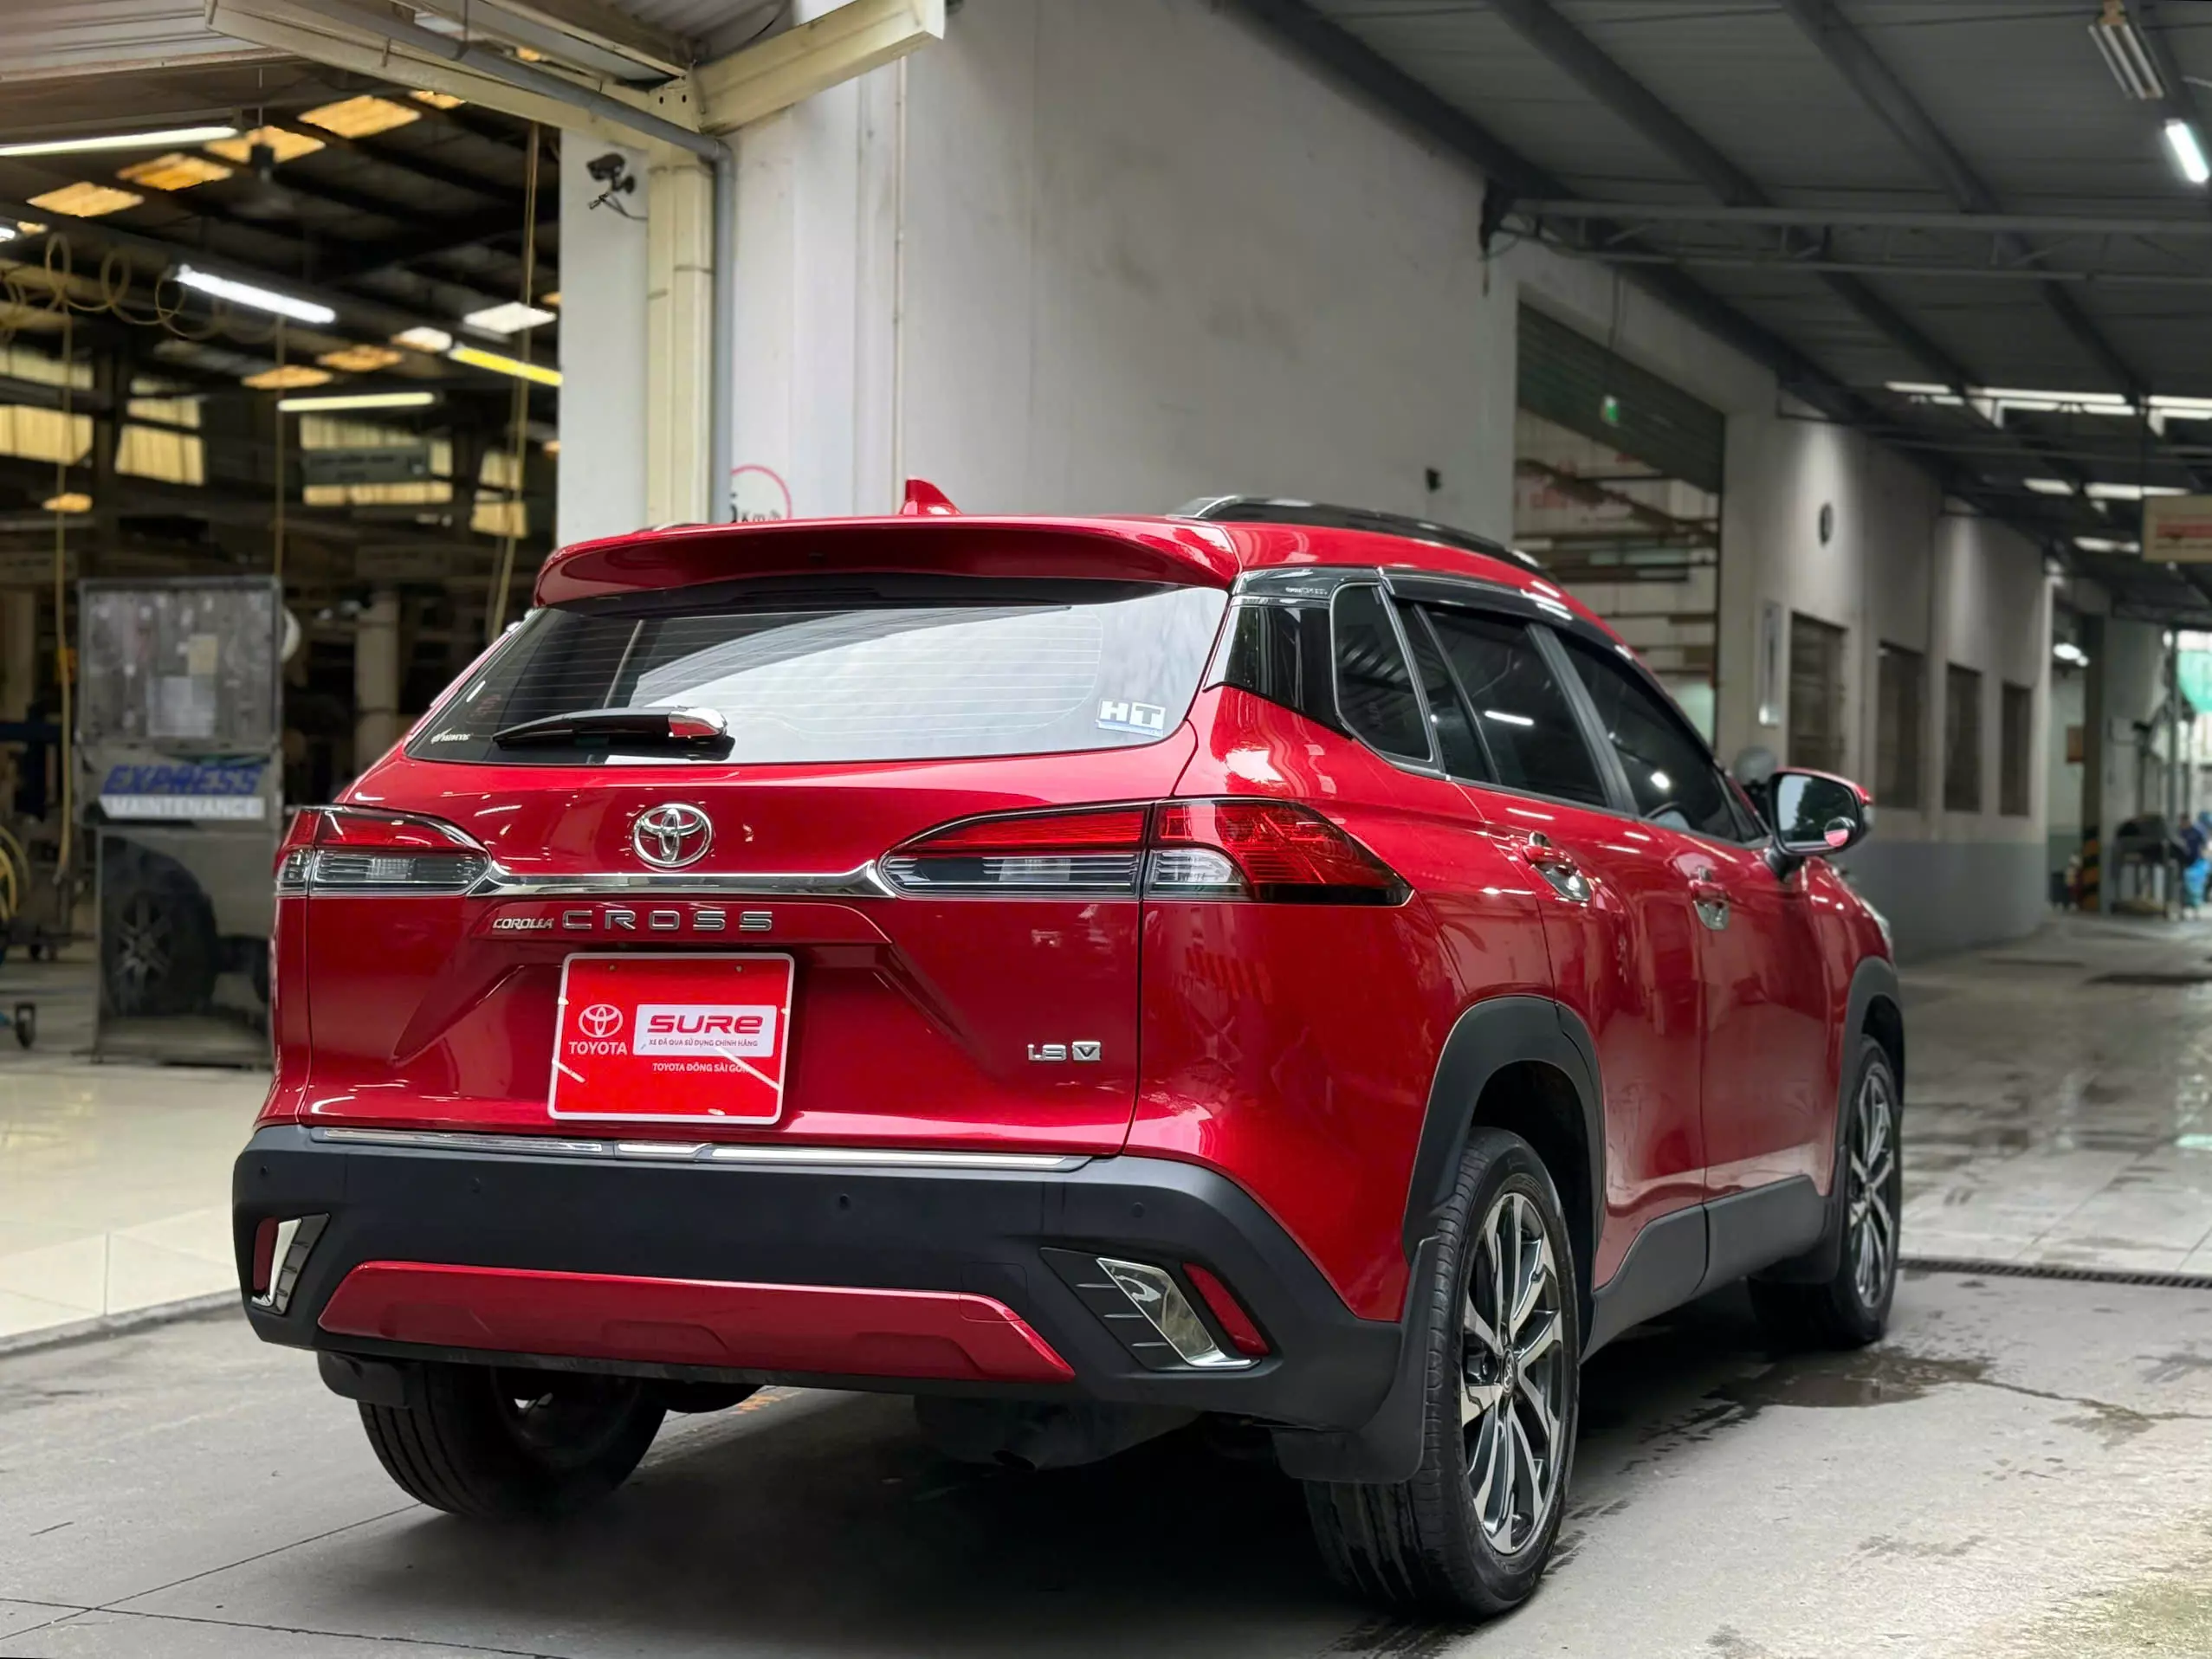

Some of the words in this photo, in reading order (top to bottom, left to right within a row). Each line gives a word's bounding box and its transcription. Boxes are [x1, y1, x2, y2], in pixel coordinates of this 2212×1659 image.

[102, 764, 263, 795] EXPRESS
[110, 795, 263, 819] MAINTENANCE
[492, 917, 554, 930] COROLLA
[562, 909, 773, 932] CROSS
[568, 1041, 628, 1055] TOYOTA
[652, 1062, 686, 1072] TOYOTA
[686, 1062, 712, 1072] ĐÔNG
